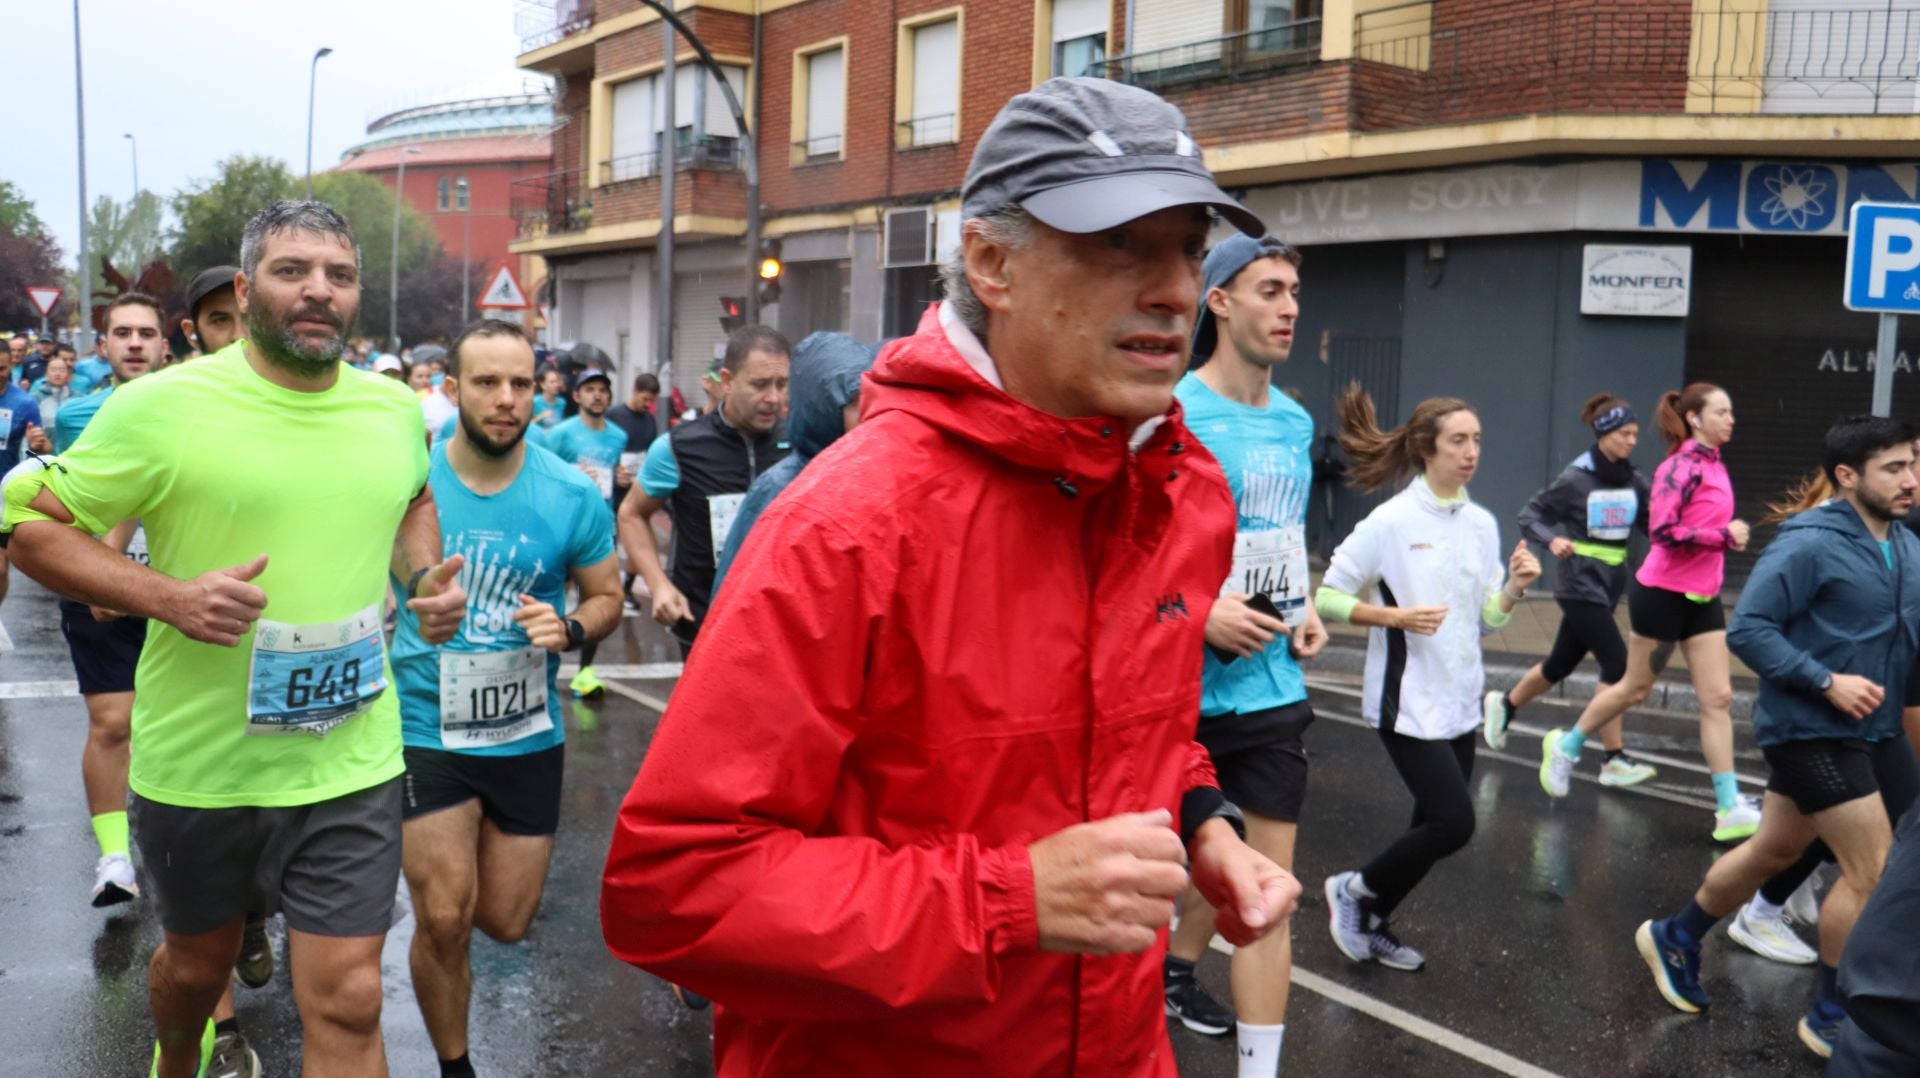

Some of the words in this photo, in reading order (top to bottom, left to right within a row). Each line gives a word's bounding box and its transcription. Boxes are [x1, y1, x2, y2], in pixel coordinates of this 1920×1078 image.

[1279, 183, 1369, 225] JVC
[1407, 172, 1550, 212] SONY
[1867, 217, 1920, 299] P
[1588, 275, 1686, 289] MONFER
[1244, 563, 1290, 599] 1144
[286, 657, 361, 709] 649
[470, 679, 527, 721] 1021
